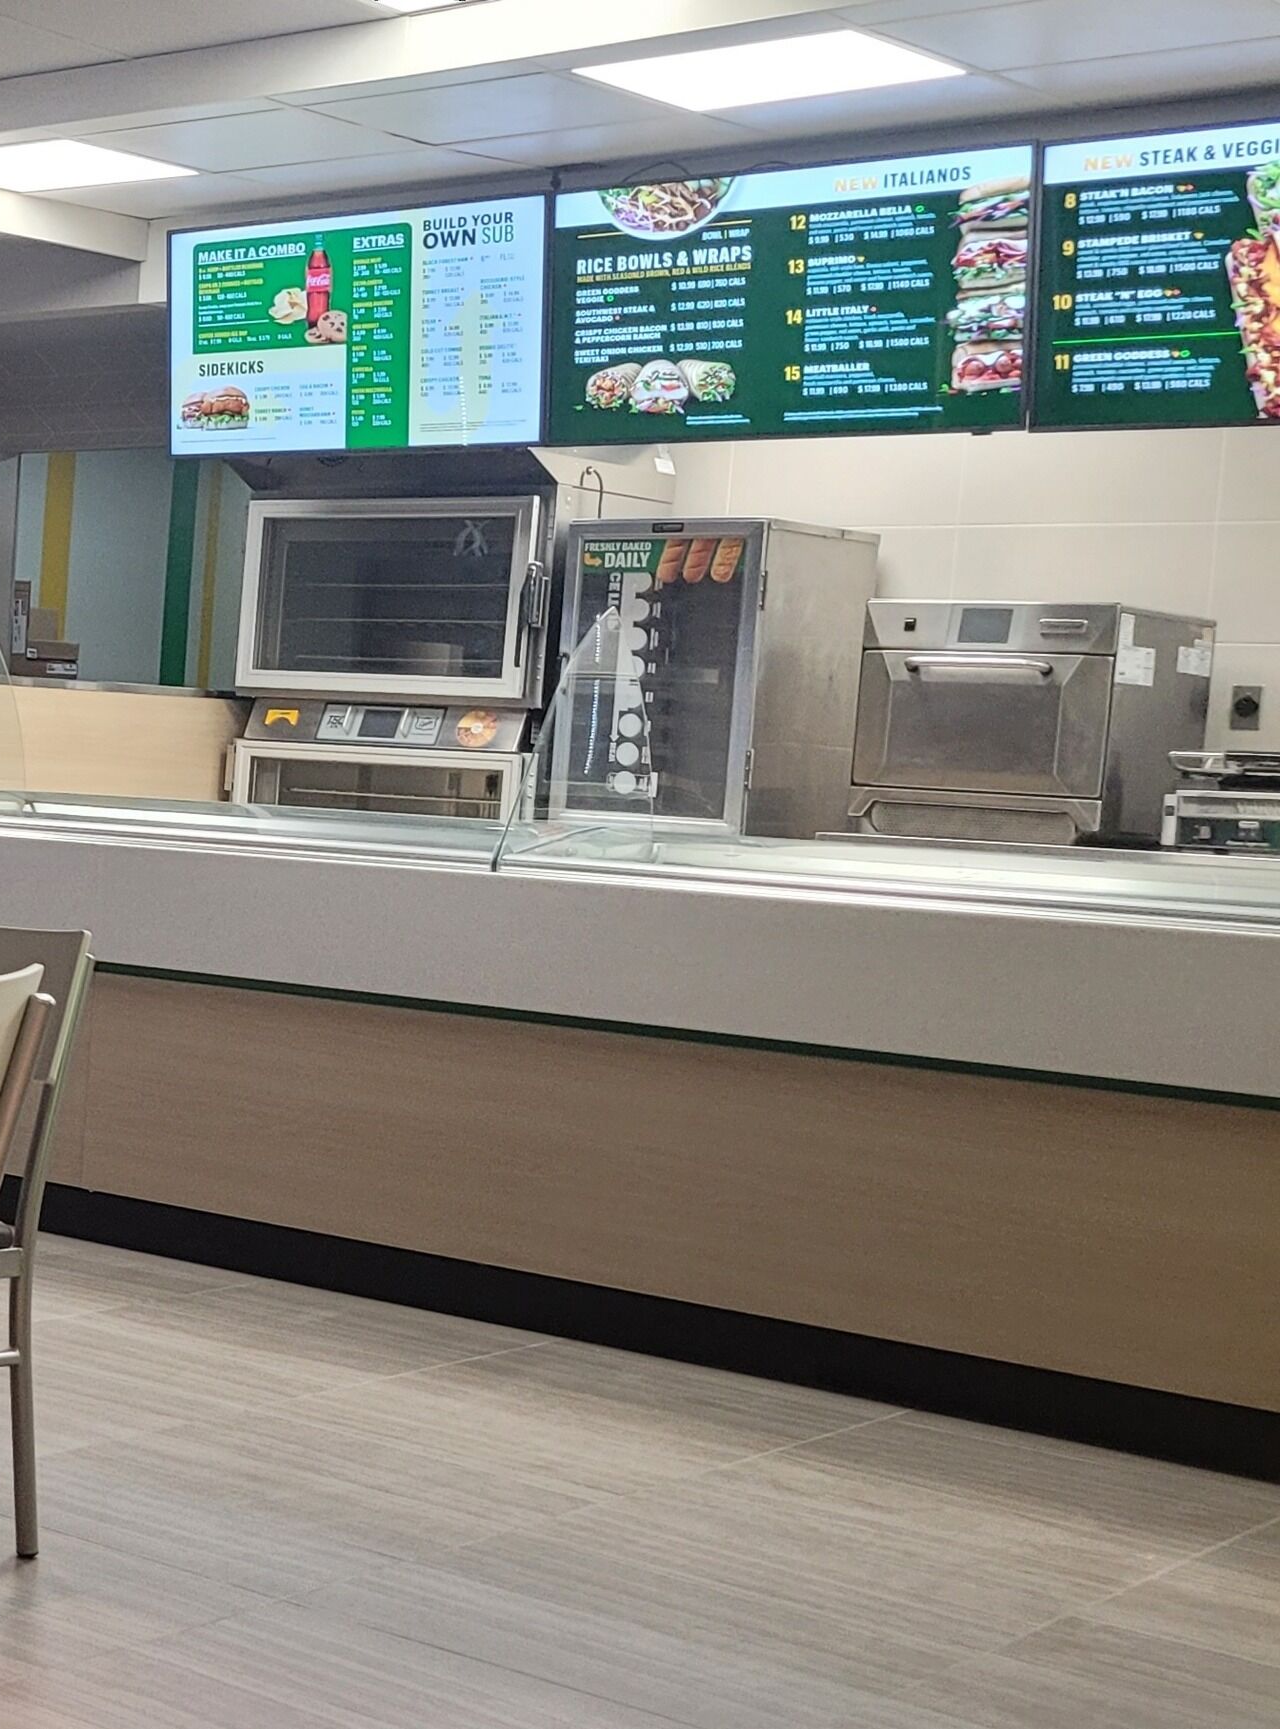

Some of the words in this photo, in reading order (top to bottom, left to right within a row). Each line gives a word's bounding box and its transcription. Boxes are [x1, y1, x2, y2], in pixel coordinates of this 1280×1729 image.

[1084, 155, 1132, 171] NEW
[1139, 146, 1197, 167] STEAK
[1203, 145, 1216, 160] &
[834, 177, 878, 192] NEW
[884, 166, 972, 189] ITALIANOS
[1064, 193, 1077, 209] 8
[1130, 184, 1174, 197] BACON
[1198, 205, 1221, 215] CALS
[423, 216, 467, 232] BUILD
[472, 211, 514, 227] YOUR
[790, 215, 806, 230] 12
[809, 208, 878, 222] MOZZARELLA
[879, 205, 912, 216] BELLA
[422, 228, 476, 249] OWN
[482, 224, 514, 244] SUB
[702, 231, 723, 241] BOWL
[728, 228, 750, 238] WRAP
[916, 226, 935, 235] CALS
[352, 233, 404, 249] EXTRAS
[1062, 240, 1075, 256] 9
[1077, 235, 1140, 249] STAMPEDE
[1141, 231, 1192, 244] BRISKET
[198, 250, 233, 263] MAKE
[234, 248, 245, 260] IT
[247, 247, 257, 258] A
[258, 243, 306, 257] COMBO
[577, 257, 613, 274] RICE
[617, 252, 673, 272] BOWLS
[677, 251, 689, 267] &
[692, 245, 752, 266] WRAPS
[788, 259, 804, 274] 13
[808, 255, 856, 267] SUPRIMO
[1196, 261, 1219, 271] CALS
[595, 274, 612, 282] WITH
[672, 268, 684, 277] RED
[692, 266, 708, 275] WILD
[710, 265, 724, 273] RICE
[728, 277, 746, 286] CALS
[910, 278, 930, 288] CALS
[576, 289, 601, 297] GREEN
[603, 286, 639, 295] GODDESS
[576, 295, 604, 304] VEGGIE
[728, 298, 745, 307] CALS
[1052, 294, 1073, 311] 10
[1075, 291, 1114, 303] STEAK
[1137, 289, 1163, 300] EGG
[575, 307, 622, 317] SOUTHWEST
[623, 305, 648, 314] STEAK
[785, 309, 803, 325] 14
[806, 307, 840, 318] LITTLE
[841, 305, 869, 315] ITALY
[1193, 309, 1216, 319] CALS
[575, 315, 614, 324] AVOCADO
[726, 319, 744, 328] CALS
[575, 329, 602, 337] CRISPY
[604, 327, 639, 335] CHICKEN
[640, 325, 667, 333] BACON
[582, 334, 632, 343] PEPPERCORN
[633, 332, 661, 340] RANCH
[910, 337, 930, 346] CALS
[725, 340, 743, 349] CALS
[574, 349, 600, 357] SWEET
[601, 347, 627, 355] ONION
[628, 345, 663, 354] CHICKEN
[1054, 354, 1070, 370] 11
[1073, 351, 1113, 363] GREEN
[1114, 349, 1170, 362] GODDESS
[199, 360, 264, 377] SIDEKICKS
[784, 365, 801, 381] 15
[803, 362, 870, 374] MEATBALLER
[908, 382, 928, 391] CALS
[1188, 378, 1211, 388] CALS
[585, 542, 621, 551] FRESHLY
[622, 542, 652, 551] BAKED
[604, 552, 651, 568] DAILY
